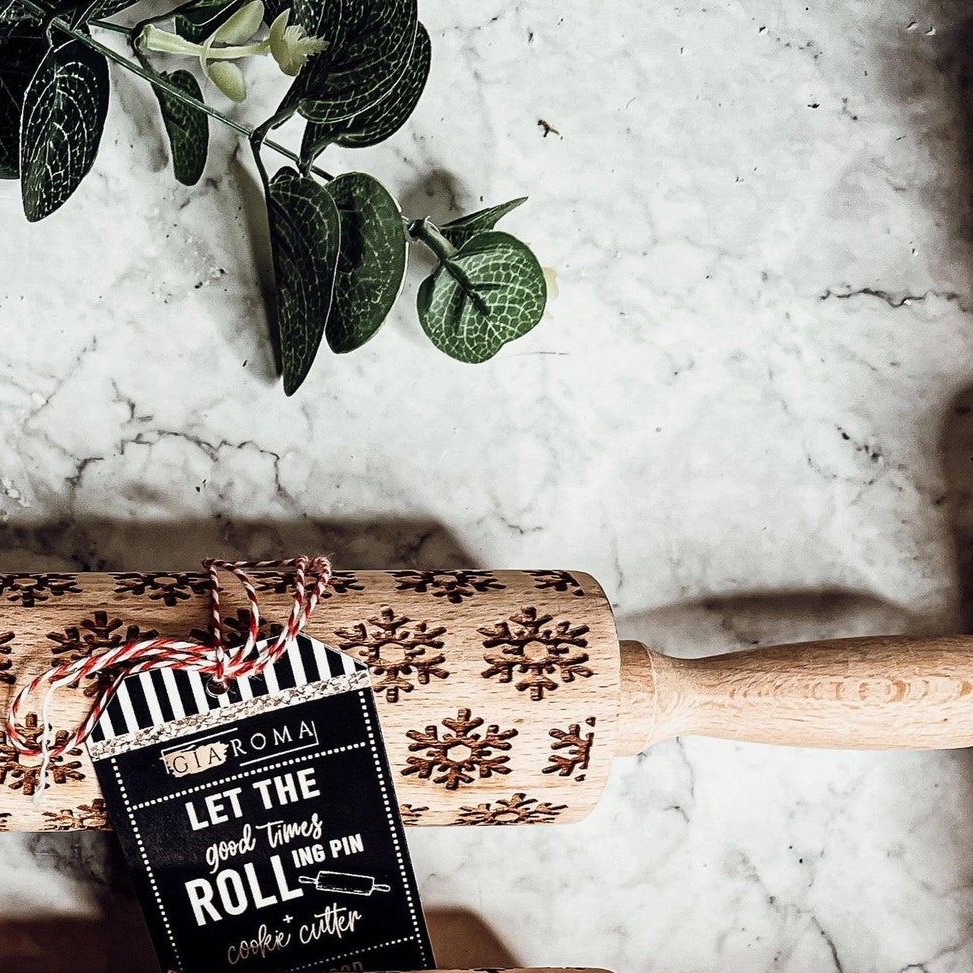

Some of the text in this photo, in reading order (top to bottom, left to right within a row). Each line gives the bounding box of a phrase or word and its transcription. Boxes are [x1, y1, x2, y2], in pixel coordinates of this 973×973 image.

[185, 767, 321, 831] LET THE
[206, 812, 323, 874] good times
[184, 833, 364, 927] ROLL ING PIN
[227, 902, 362, 965] cookie cutter
